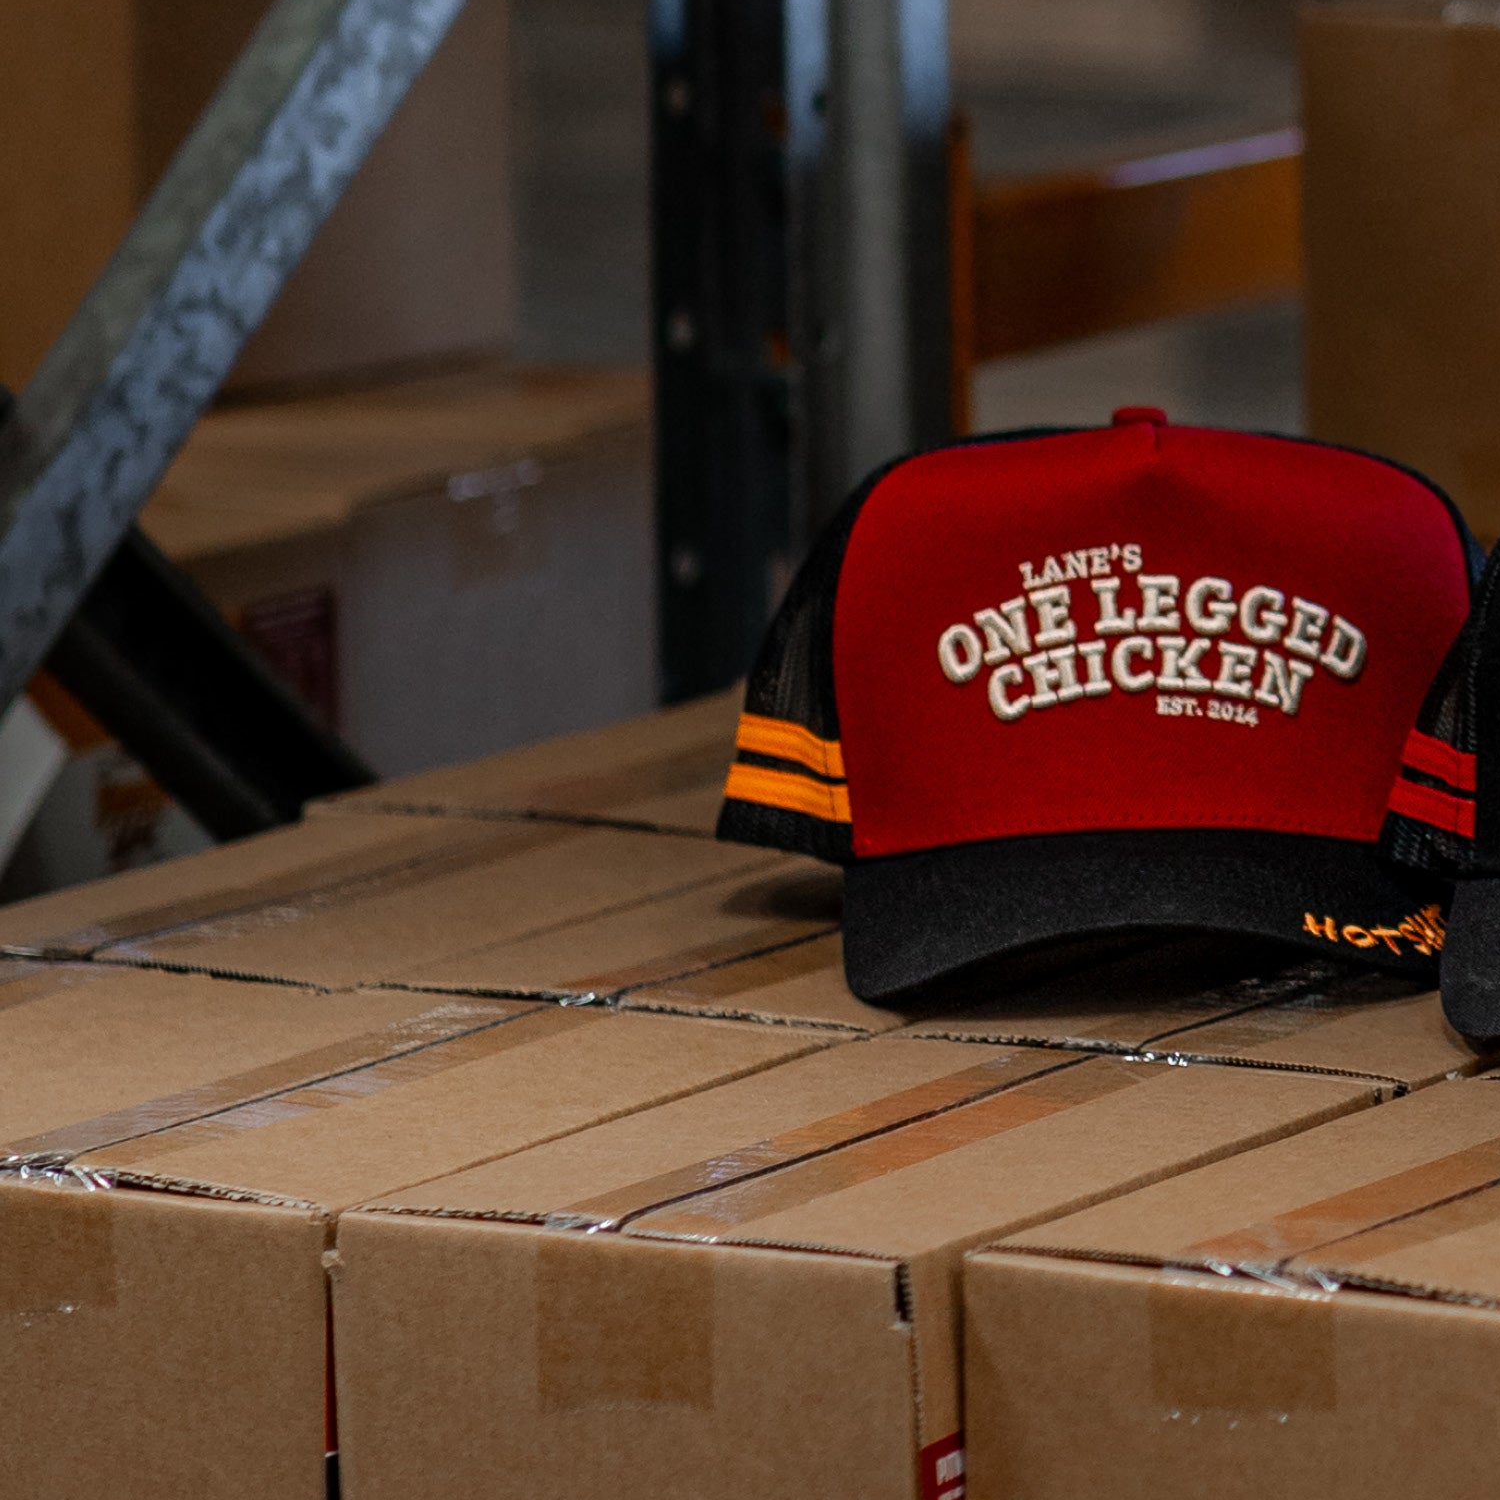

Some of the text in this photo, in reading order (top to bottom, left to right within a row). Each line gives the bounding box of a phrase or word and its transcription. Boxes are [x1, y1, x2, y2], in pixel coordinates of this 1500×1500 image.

[1019, 542, 1143, 590] LANE'S
[936, 574, 1369, 685] ONE LEGGED
[986, 634, 1315, 723] CHICKEN
[1156, 695, 1259, 728] EST. 2014
